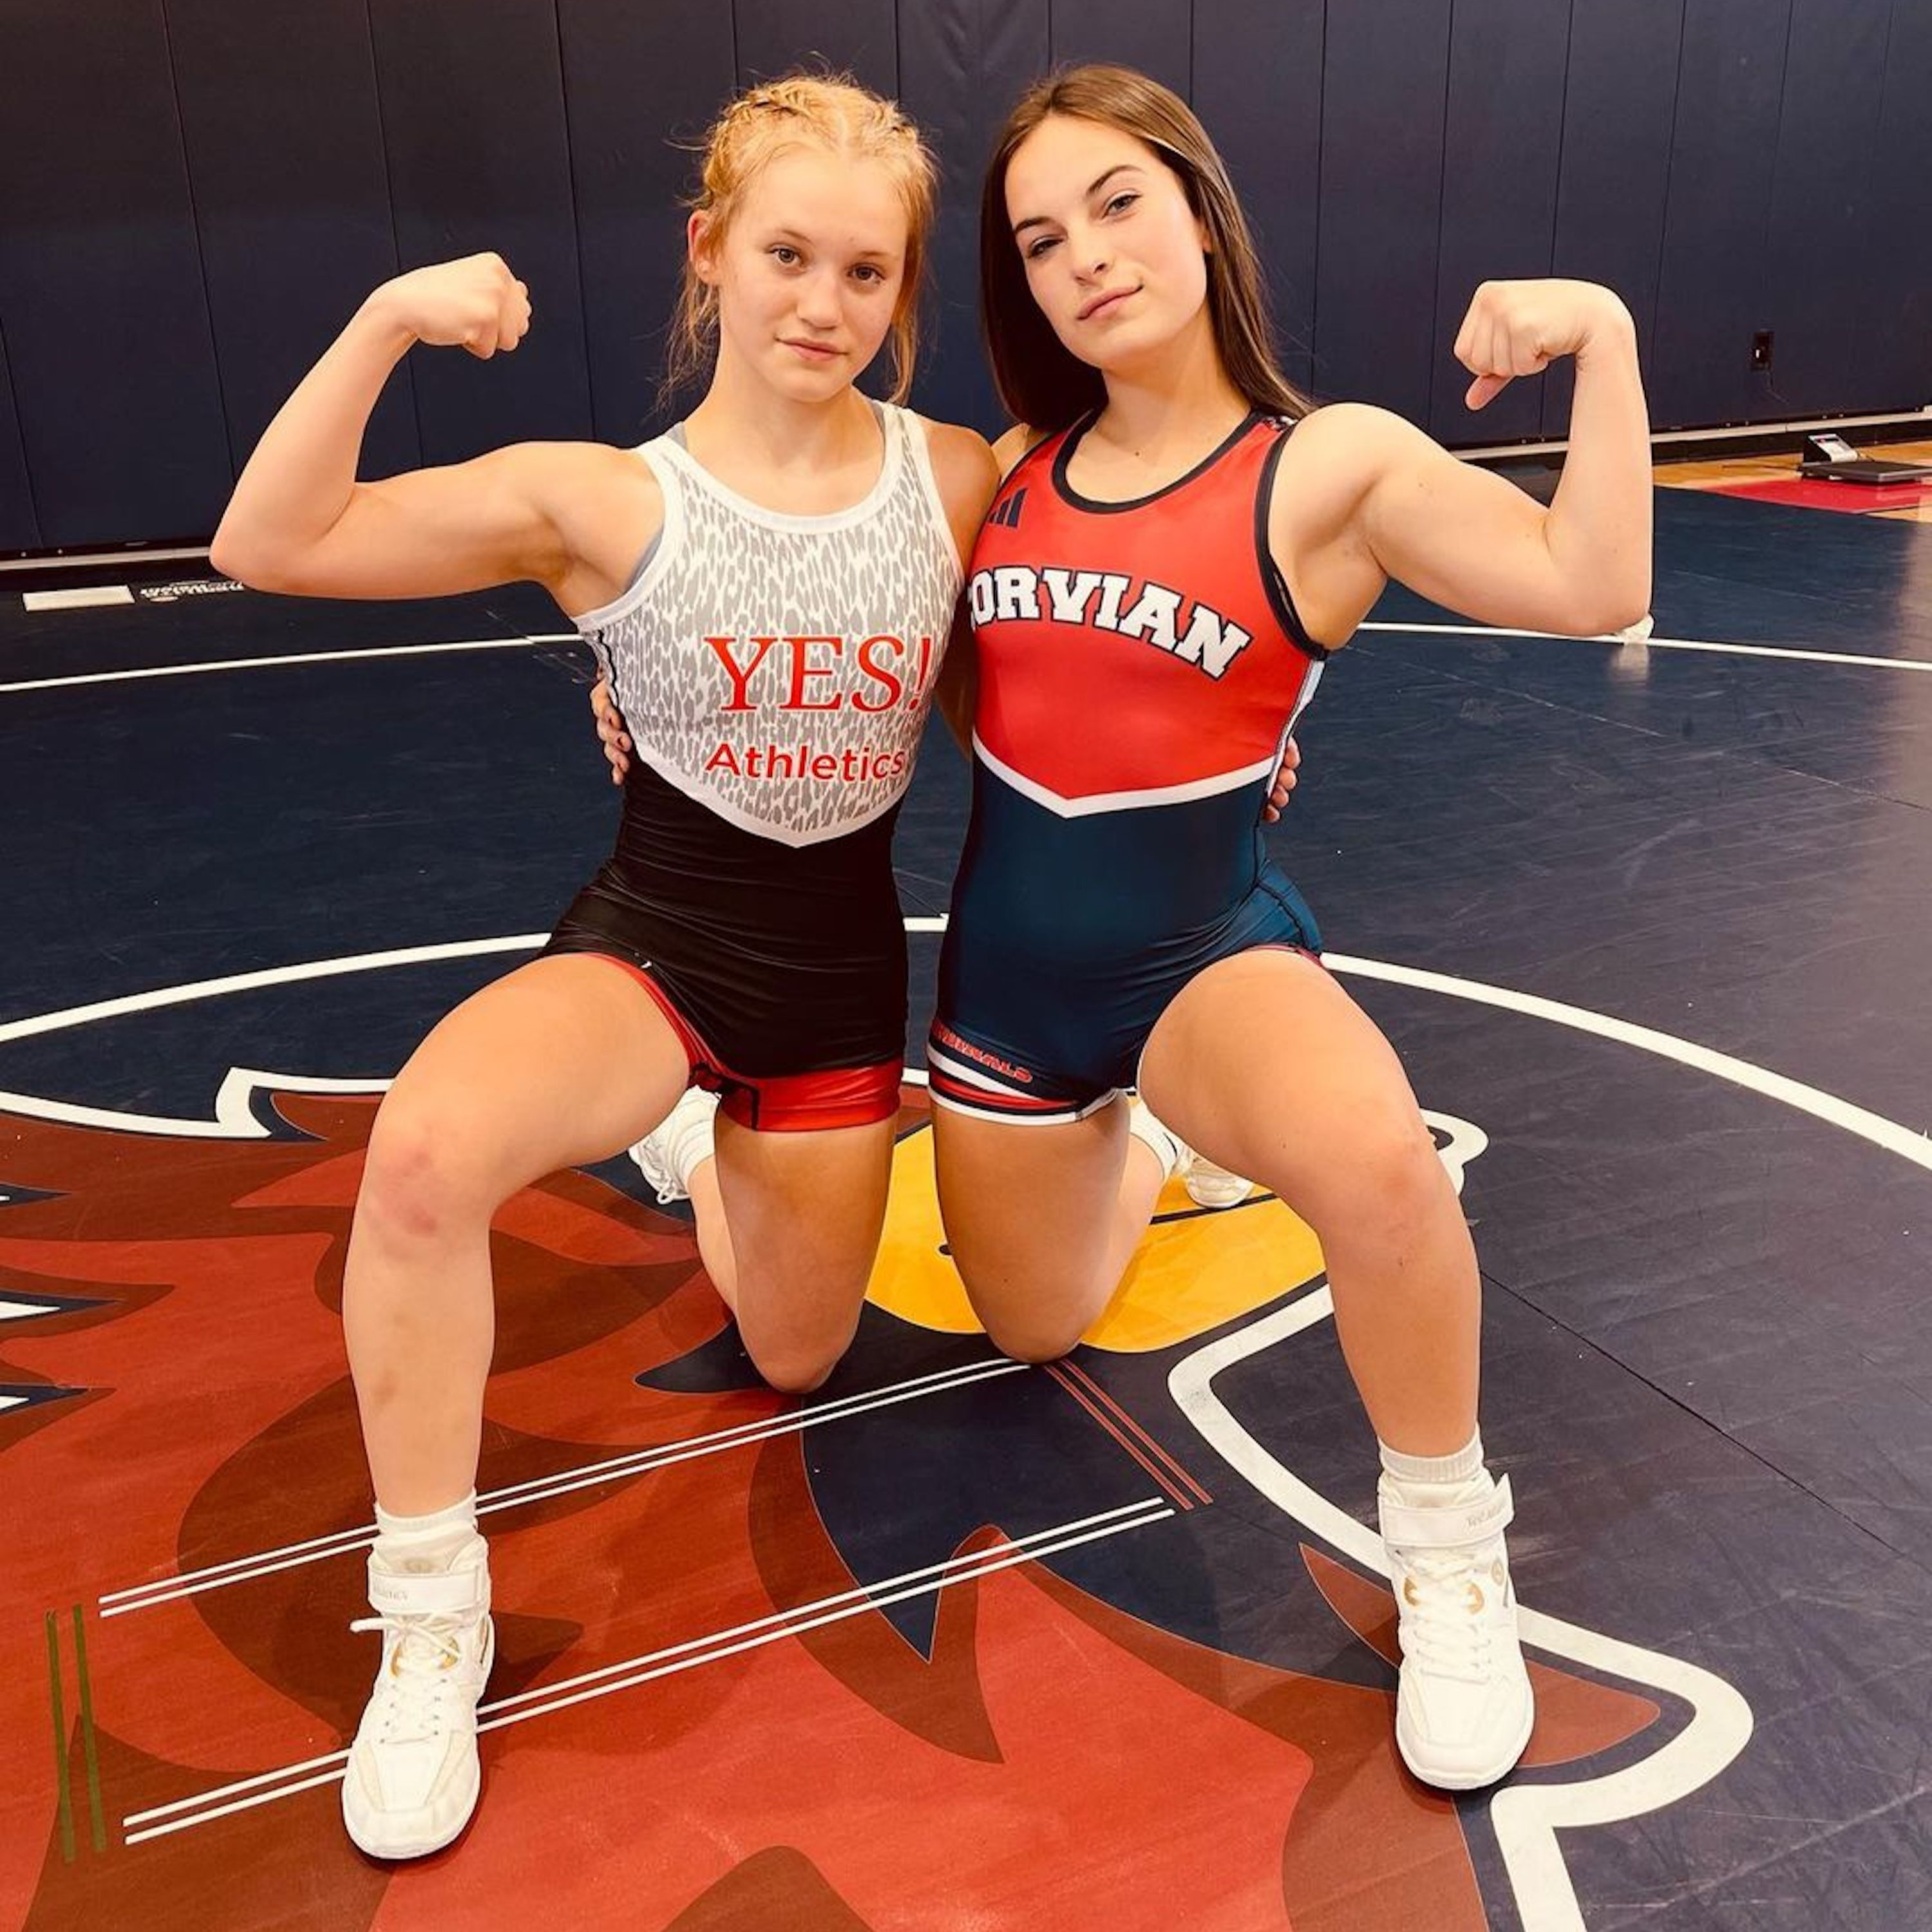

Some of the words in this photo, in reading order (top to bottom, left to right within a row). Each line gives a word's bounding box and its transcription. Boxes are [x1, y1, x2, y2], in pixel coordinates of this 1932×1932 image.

[967, 565, 1253, 681] ORVIAN
[704, 635, 931, 712] YES!
[705, 742, 905, 782] Athletics
